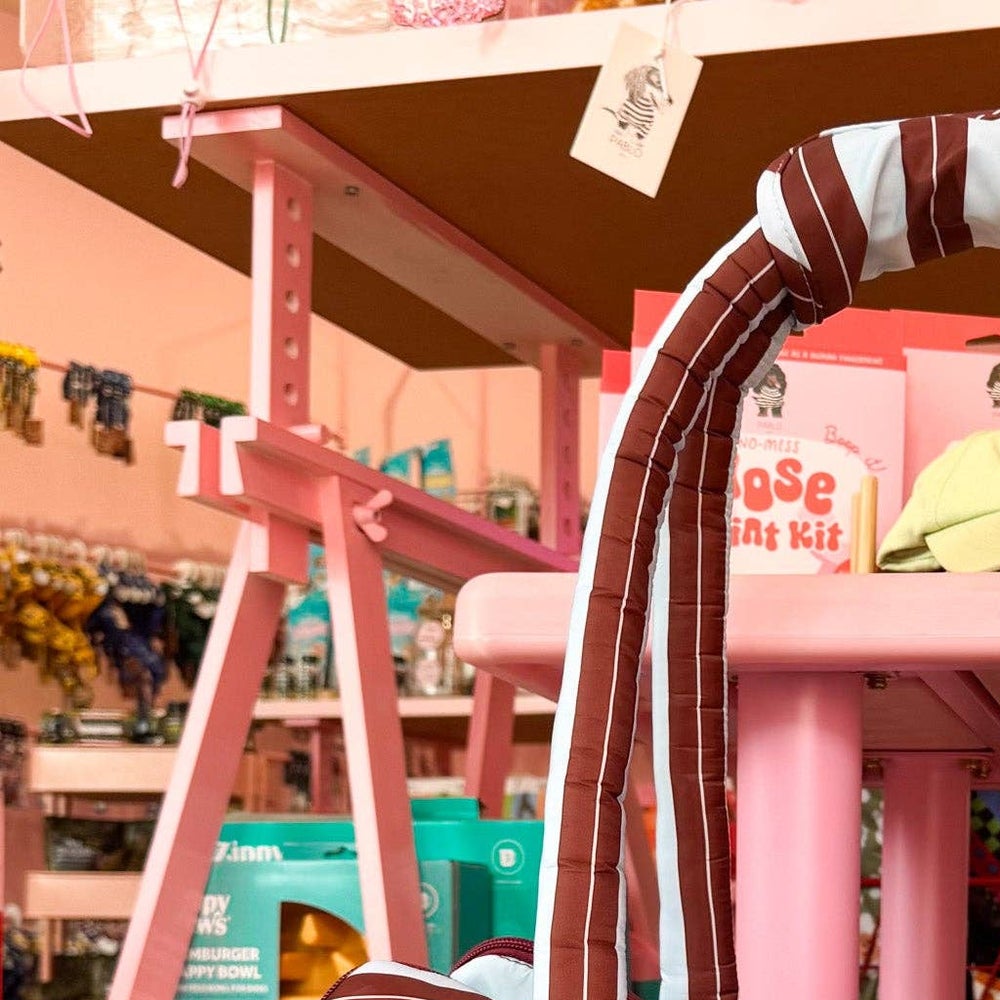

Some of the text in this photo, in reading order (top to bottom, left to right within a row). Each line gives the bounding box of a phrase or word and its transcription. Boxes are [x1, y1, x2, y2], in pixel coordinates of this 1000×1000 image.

[732, 454, 836, 516] ose
[731, 517, 780, 551] int
[188, 947, 260, 961] MBURGER
[217, 965, 262, 979] BOWL
